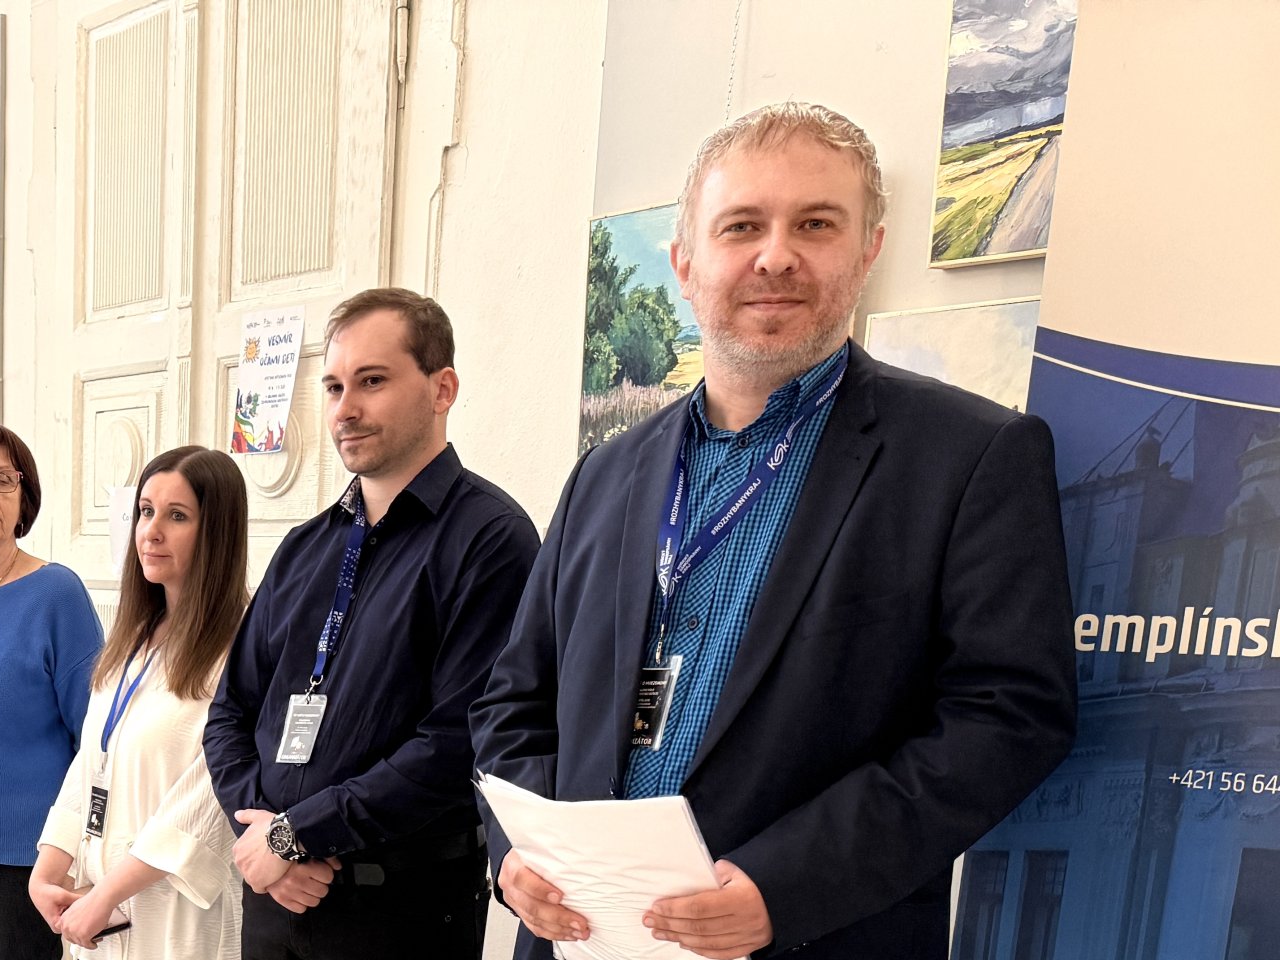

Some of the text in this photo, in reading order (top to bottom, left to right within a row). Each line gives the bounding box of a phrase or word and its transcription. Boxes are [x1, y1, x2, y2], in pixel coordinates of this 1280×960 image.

[710, 478, 761, 536] #ROZHYBANYKRAJ
[1168, 769, 1280, 794] +421 56 64
